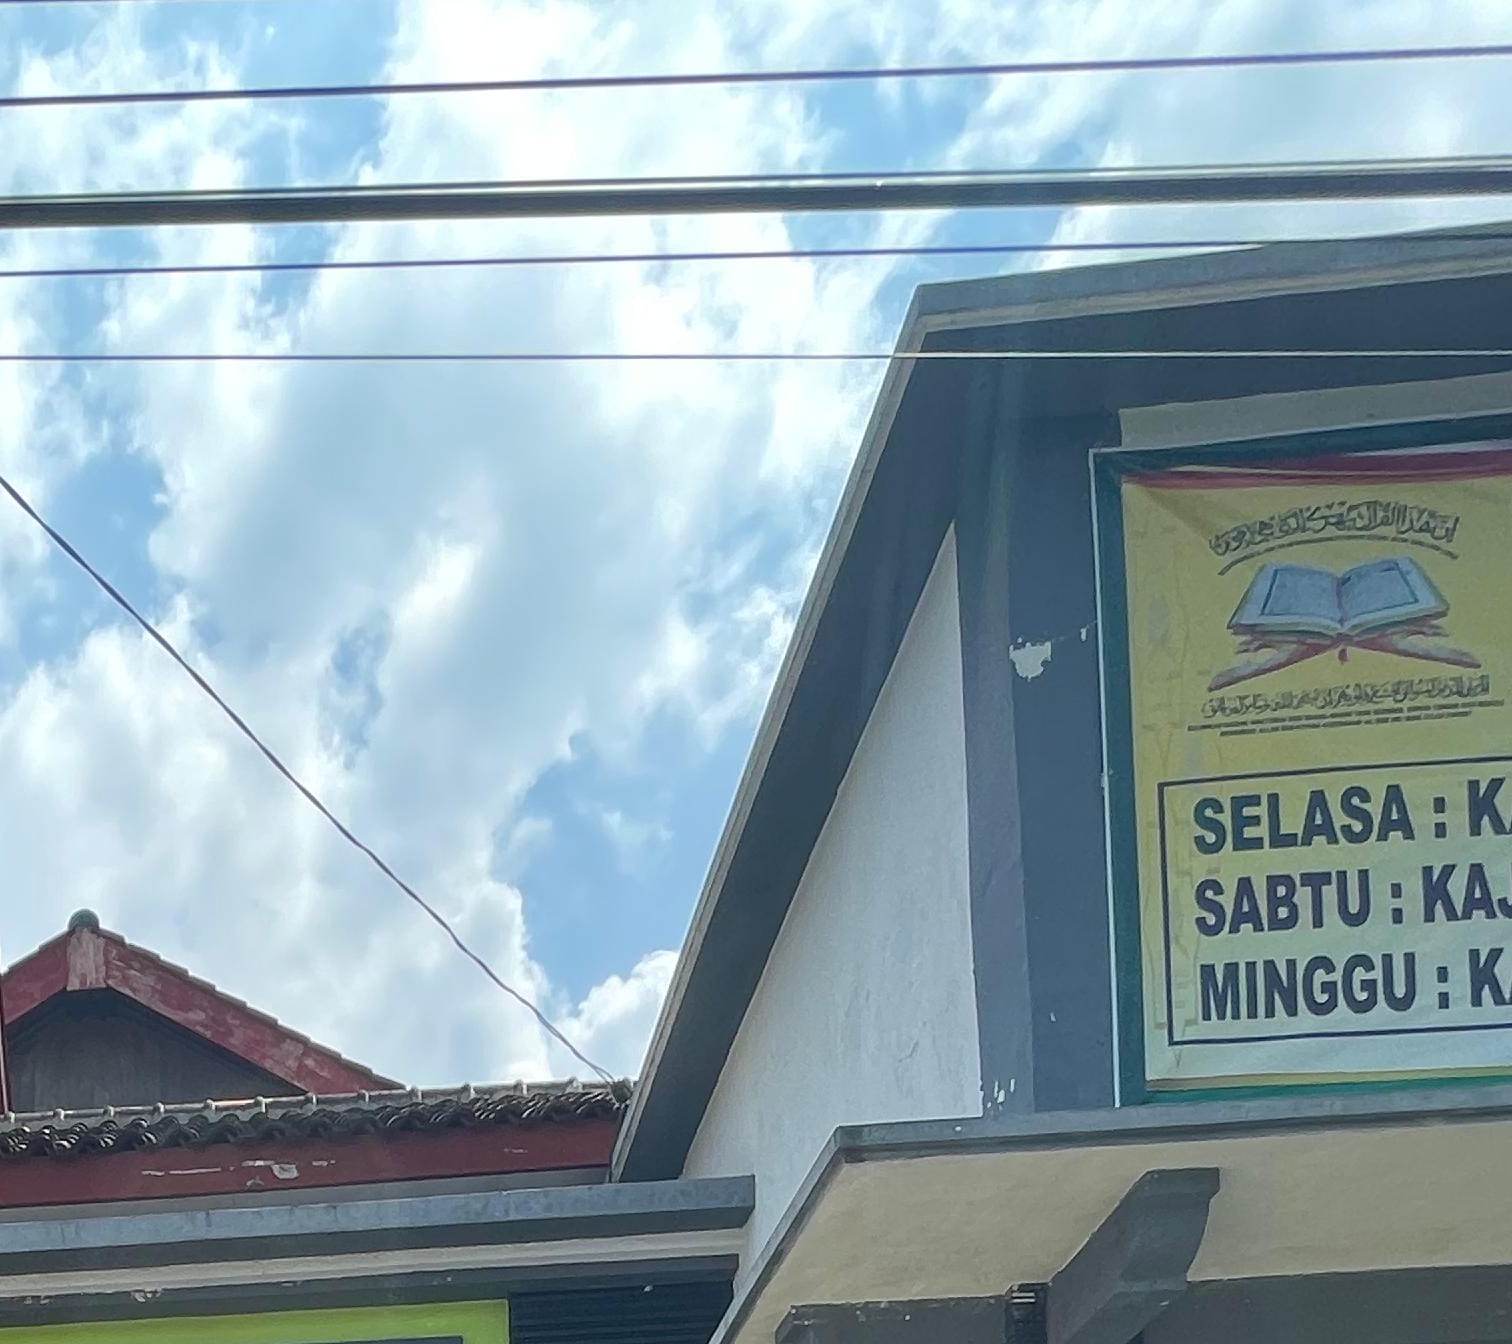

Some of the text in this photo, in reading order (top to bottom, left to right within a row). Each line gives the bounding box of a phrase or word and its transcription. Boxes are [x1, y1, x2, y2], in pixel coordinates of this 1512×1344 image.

[1193, 783, 1416, 855] SELASA
[1467, 777, 1512, 837] K
[1194, 868, 1372, 937] SABTU
[1199, 951, 1417, 1022] MINGGU
[1468, 947, 1512, 1008] K
